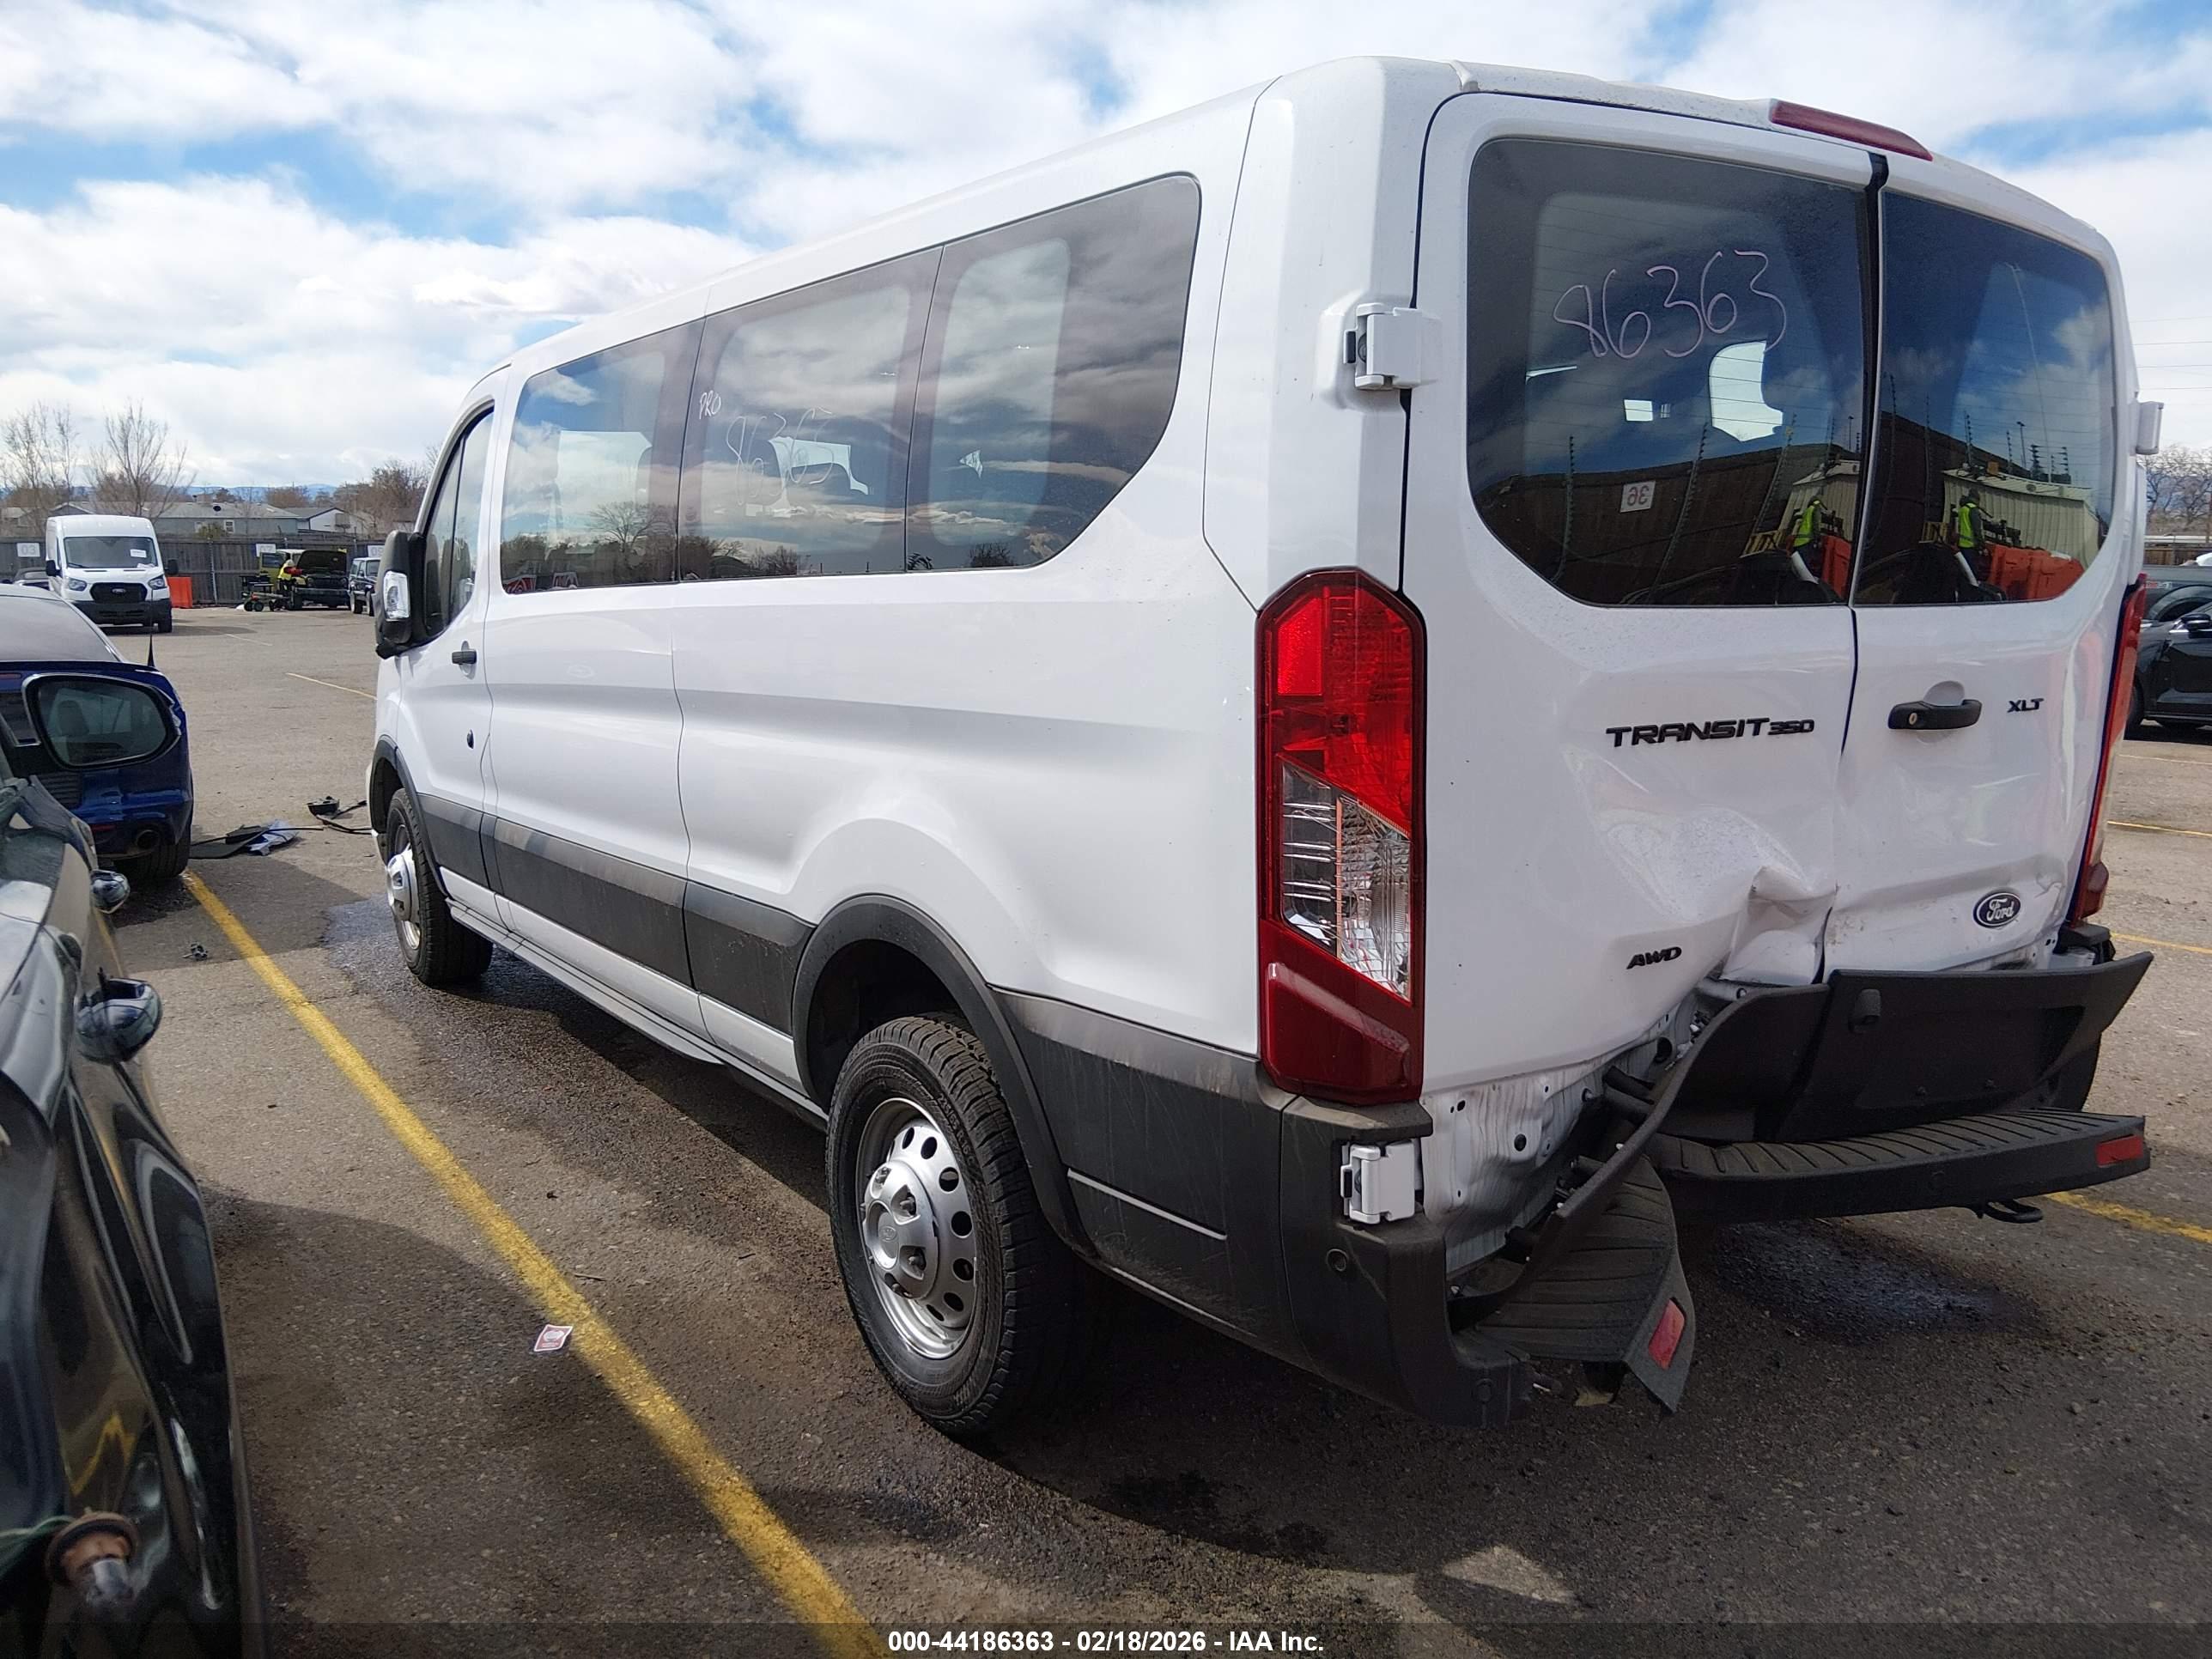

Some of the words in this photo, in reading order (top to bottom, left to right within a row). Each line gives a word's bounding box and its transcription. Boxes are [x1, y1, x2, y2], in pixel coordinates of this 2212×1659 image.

[1553, 249, 1787, 359] 86363
[699, 390, 722, 420] PRO
[2007, 697, 2045, 713] XLT
[1626, 946, 1682, 969] AWD
